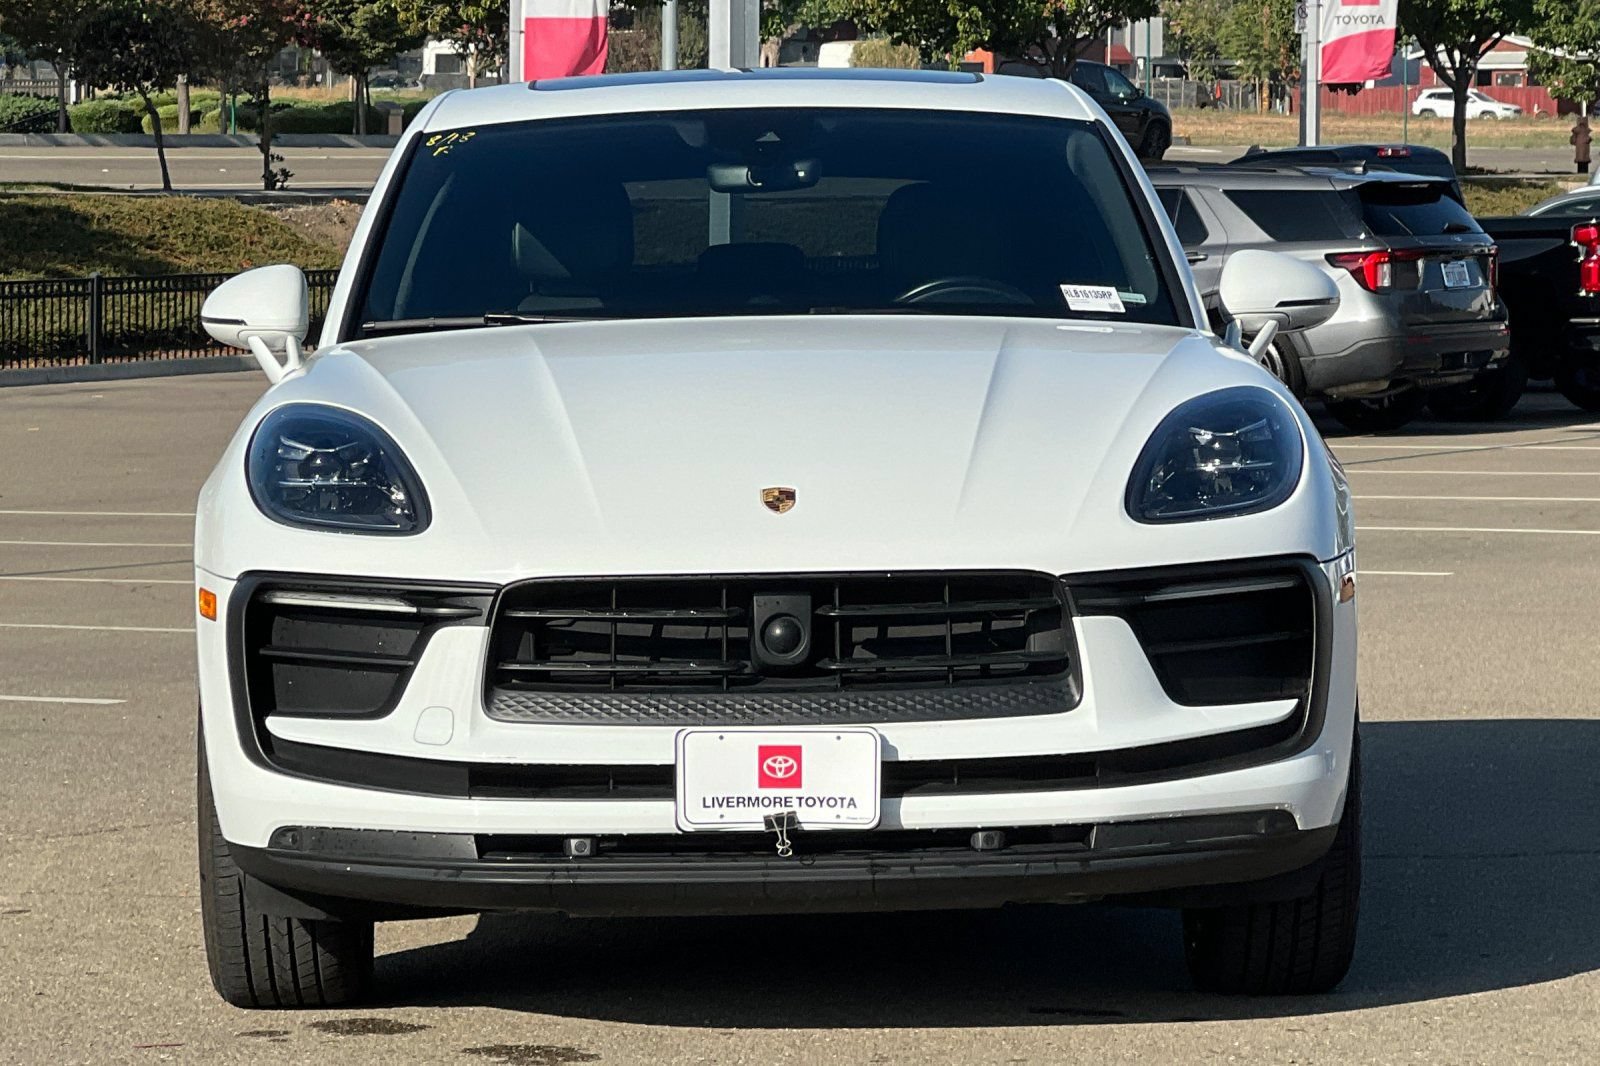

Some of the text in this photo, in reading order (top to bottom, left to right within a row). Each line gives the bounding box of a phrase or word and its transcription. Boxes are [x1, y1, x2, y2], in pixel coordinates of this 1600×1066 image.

[1335, 15, 1385, 25] TOYOTA
[702, 796, 858, 809] LIVERMORE TOYOTA
